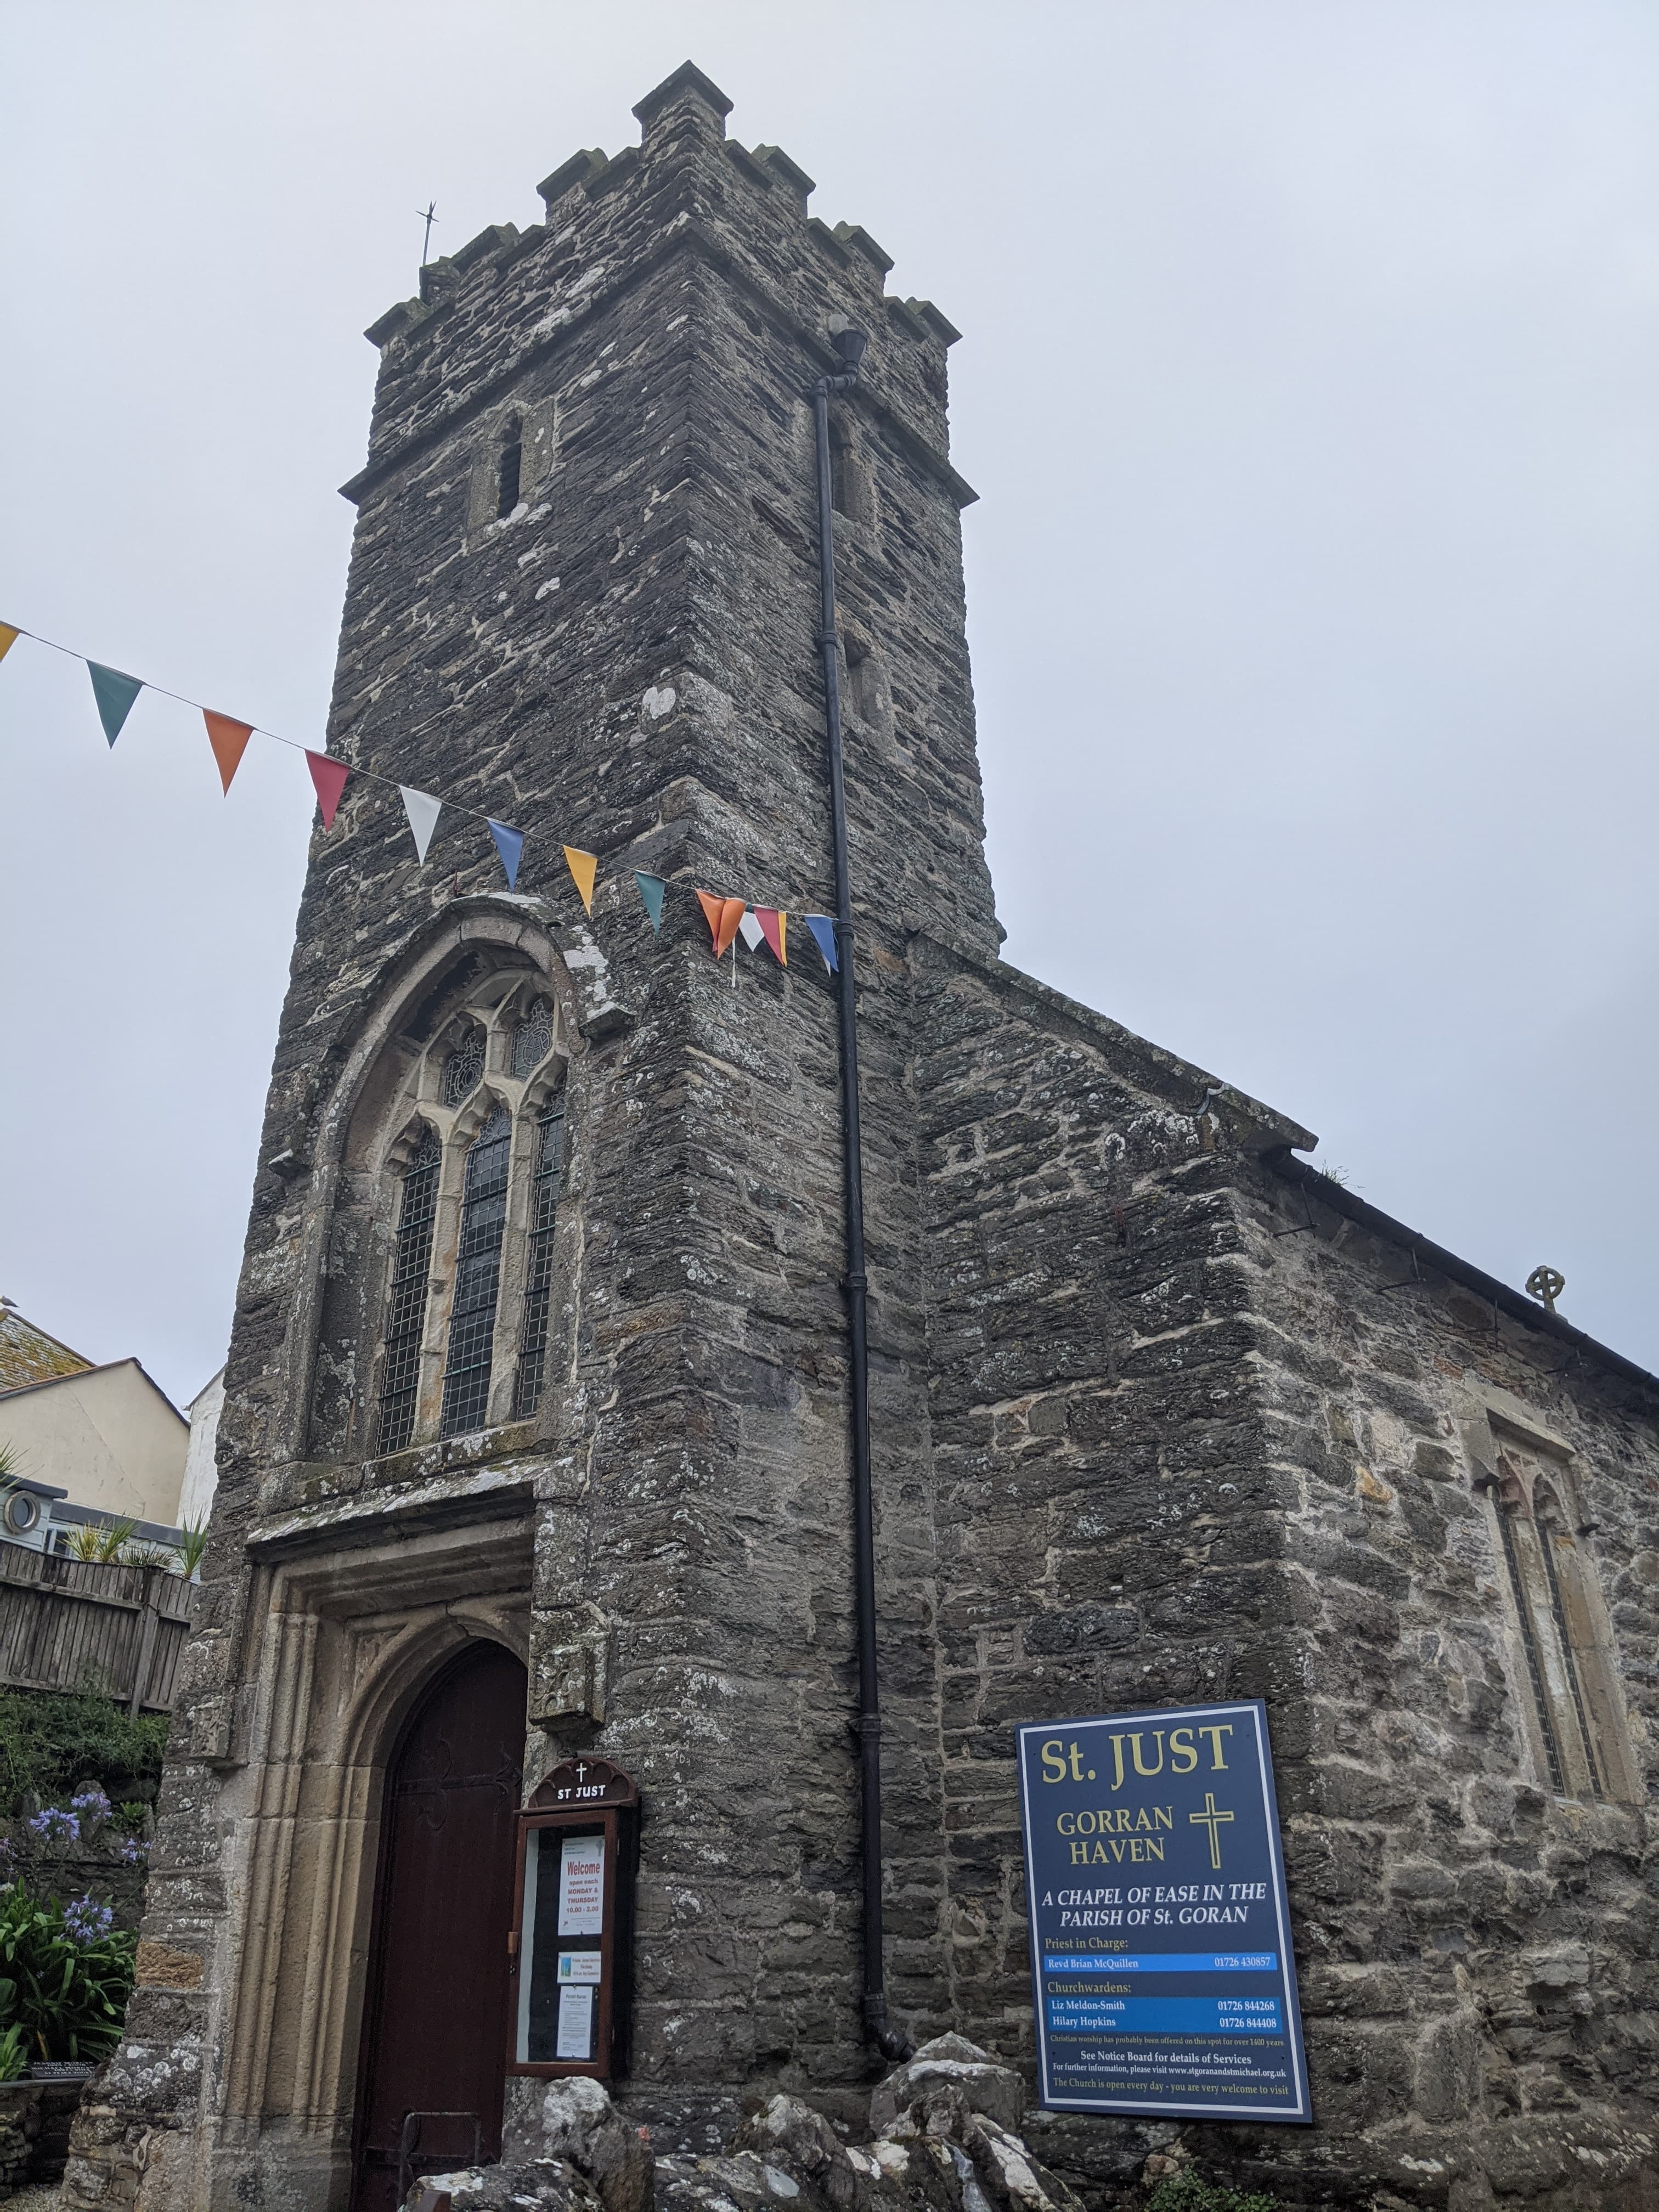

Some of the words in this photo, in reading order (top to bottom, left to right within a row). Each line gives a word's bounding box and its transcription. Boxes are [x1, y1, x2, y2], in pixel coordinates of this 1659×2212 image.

[1041, 1740, 1096, 1784] St.
[1108, 1724, 1234, 1791] JUST
[557, 1788, 572, 1799] ST
[575, 1785, 606, 1798] JUST
[1057, 1805, 1173, 1836] GORRAN
[1069, 1837, 1165, 1865] HAVEN
[567, 1860, 600, 1876] Welcome
[1041, 1891, 1053, 1906] A
[1057, 1888, 1123, 1906] CHAPEL
[1127, 1887, 1151, 1904] OF
[1154, 1885, 1199, 1903] EASE
[1201, 1884, 1224, 1901] IN
[1228, 1883, 1267, 1900] THE
[1060, 1909, 1124, 1927] PARISH
[1127, 1909, 1151, 1926] OF
[1154, 1908, 1174, 1925] St.
[1178, 1906, 1249, 1924] GORAN
[1045, 1938, 1073, 1949] Priest
[1076, 1937, 1086, 1949] in
[1088, 1937, 1129, 1951] Charge:
[1048, 1959, 1069, 1968] Revd
[1071, 1959, 1092, 1968] Brian
[1094, 1958, 1139, 1970] McQuillen
[1214, 1957, 1239, 1967] 01726
[1241, 1956, 1271, 1967] 430857
[1047, 1981, 1131, 1993] Churchwardens:
[1052, 2000, 1064, 2010] Liz
[1066, 2000, 1126, 2010] Meldon-Smith
[1218, 2000, 1243, 2011] 01726
[1244, 2000, 1275, 2011] 844268
[1052, 2016, 1079, 2029] Hilary
[1080, 2016, 1116, 2029] Hopkins
[1220, 2018, 1245, 2028] 01726
[1246, 2018, 1277, 2028] 844408
[1050, 2034, 1077, 2042] Christian
[1078, 2035, 1103, 2045] worship
[1115, 2036, 1142, 2046] probably
[1160, 2036, 1183, 2045] offered
[1207, 2038, 1221, 2047] spot
[1266, 2040, 1284, 2048] years
[1080, 2050, 1096, 2060] See
[1097, 2051, 1125, 2061] Notice
[1127, 2051, 1153, 2062] Board
[1154, 2051, 1169, 2062] for
[1170, 2052, 1200, 2063] details
[1201, 2053, 1211, 2063] of
[1213, 2053, 1252, 2064] Services
[1064, 2062, 1087, 2071] further
[1088, 2063, 1129, 2074] information,
[1130, 2064, 1151, 2075] please
[1152, 2065, 1167, 2074] visit
[1169, 2066, 1286, 2079] www.stgoranandstmichael.org.uk
[1053, 2077, 1068, 2087] The
[1069, 2078, 1097, 2088] Church
[1098, 2080, 1105, 2088] is
[1106, 2082, 1125, 2091] open
[1126, 2083, 1148, 2092] every
[1150, 2080, 1164, 2094] day
[1170, 2084, 1186, 2094] you
[1201, 2085, 1219, 2095] very
[1221, 2083, 1258, 2094] welcome
[1259, 2085, 1268, 2095] to
[1269, 2085, 1289, 2095] visit
